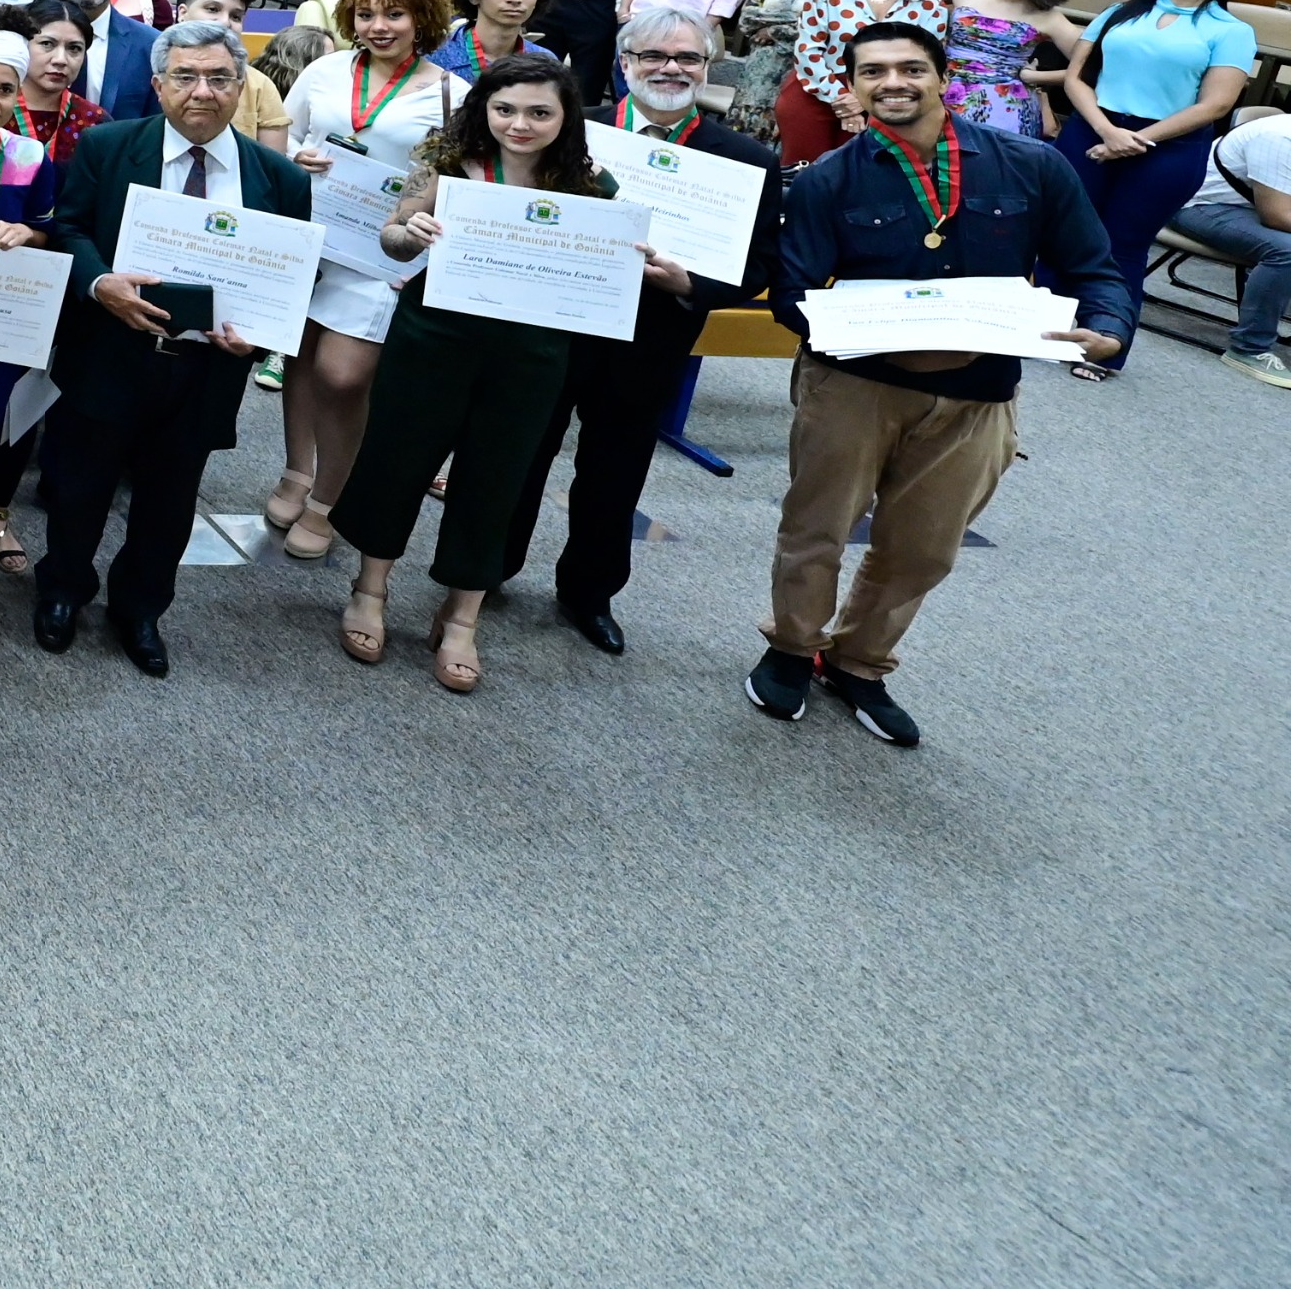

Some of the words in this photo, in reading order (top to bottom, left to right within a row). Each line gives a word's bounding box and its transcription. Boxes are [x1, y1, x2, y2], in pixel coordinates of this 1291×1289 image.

[464, 226, 503, 239] Câmara
[506, 232, 557, 248] Municipal
[561, 241, 571, 250] de
[574, 243, 615, 256] Goiânia
